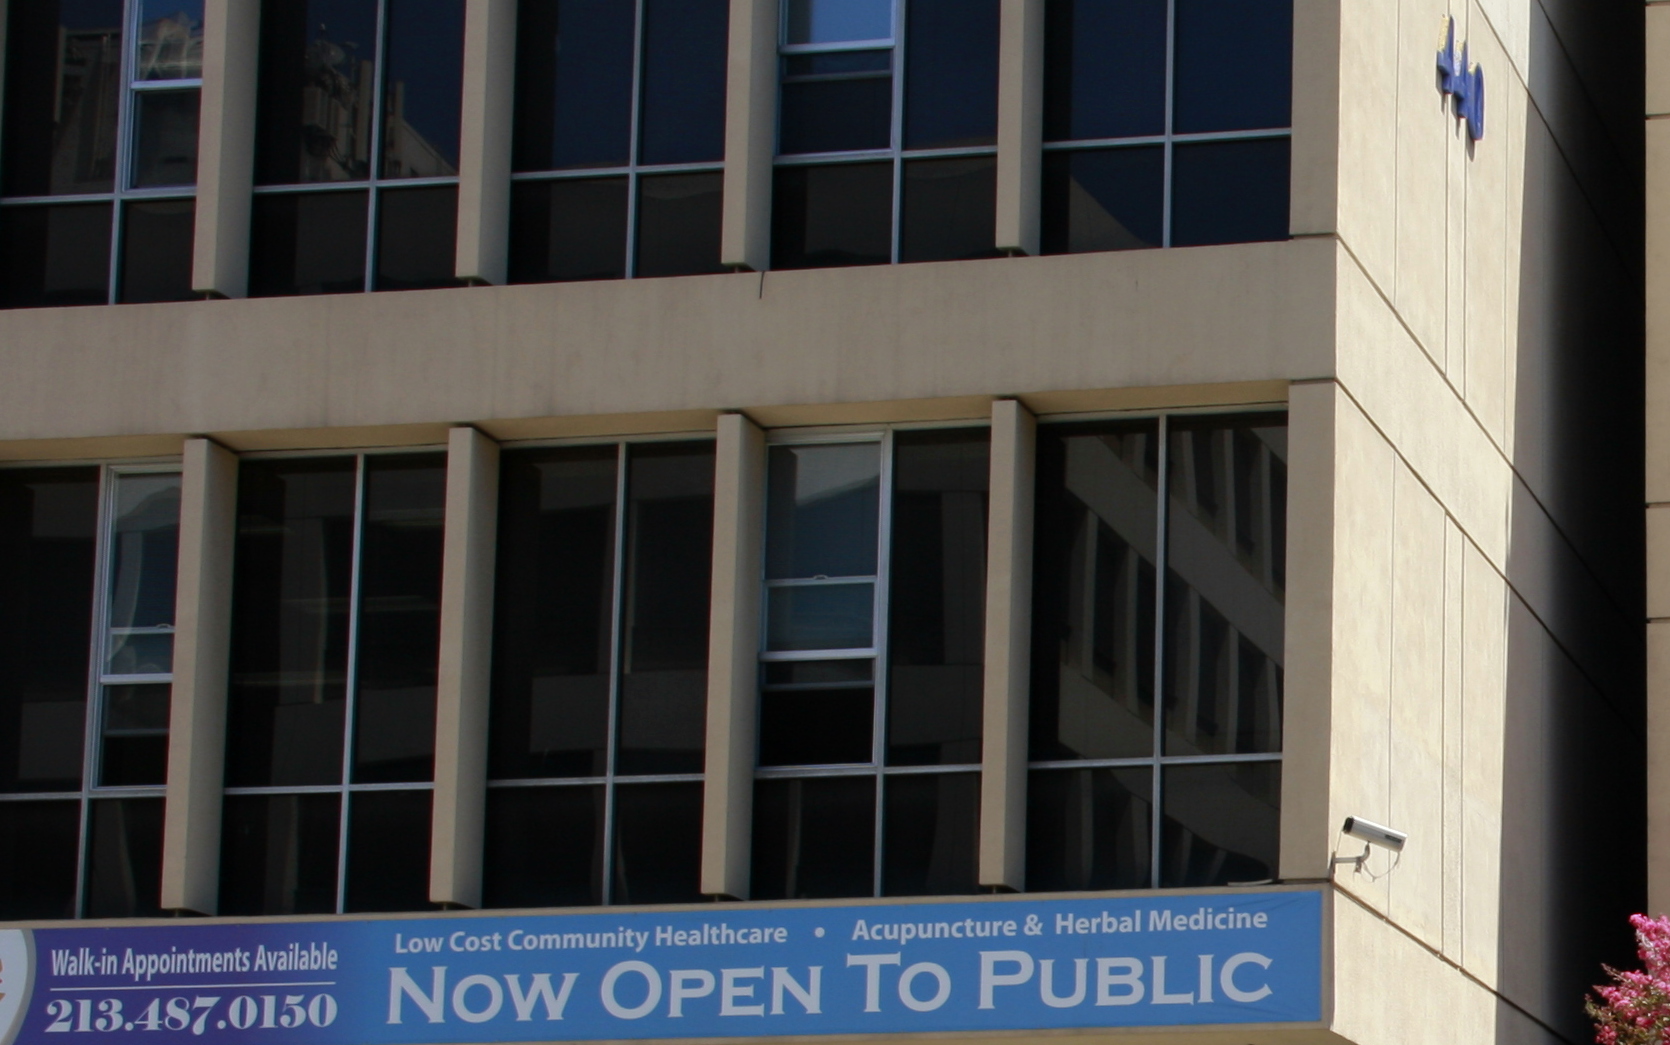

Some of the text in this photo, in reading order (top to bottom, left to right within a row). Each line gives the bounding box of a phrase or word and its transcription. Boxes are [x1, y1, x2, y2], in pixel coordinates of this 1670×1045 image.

[395, 907, 1268, 954] Low Cost Community Healthcare Acupuncture & Herbal Medicine
[51, 941, 338, 981] Walk-in Appointments Available
[386, 949, 1274, 1024] NOW OPEN TO PUBLIC
[45, 993, 337, 1035] 213.487.0150
